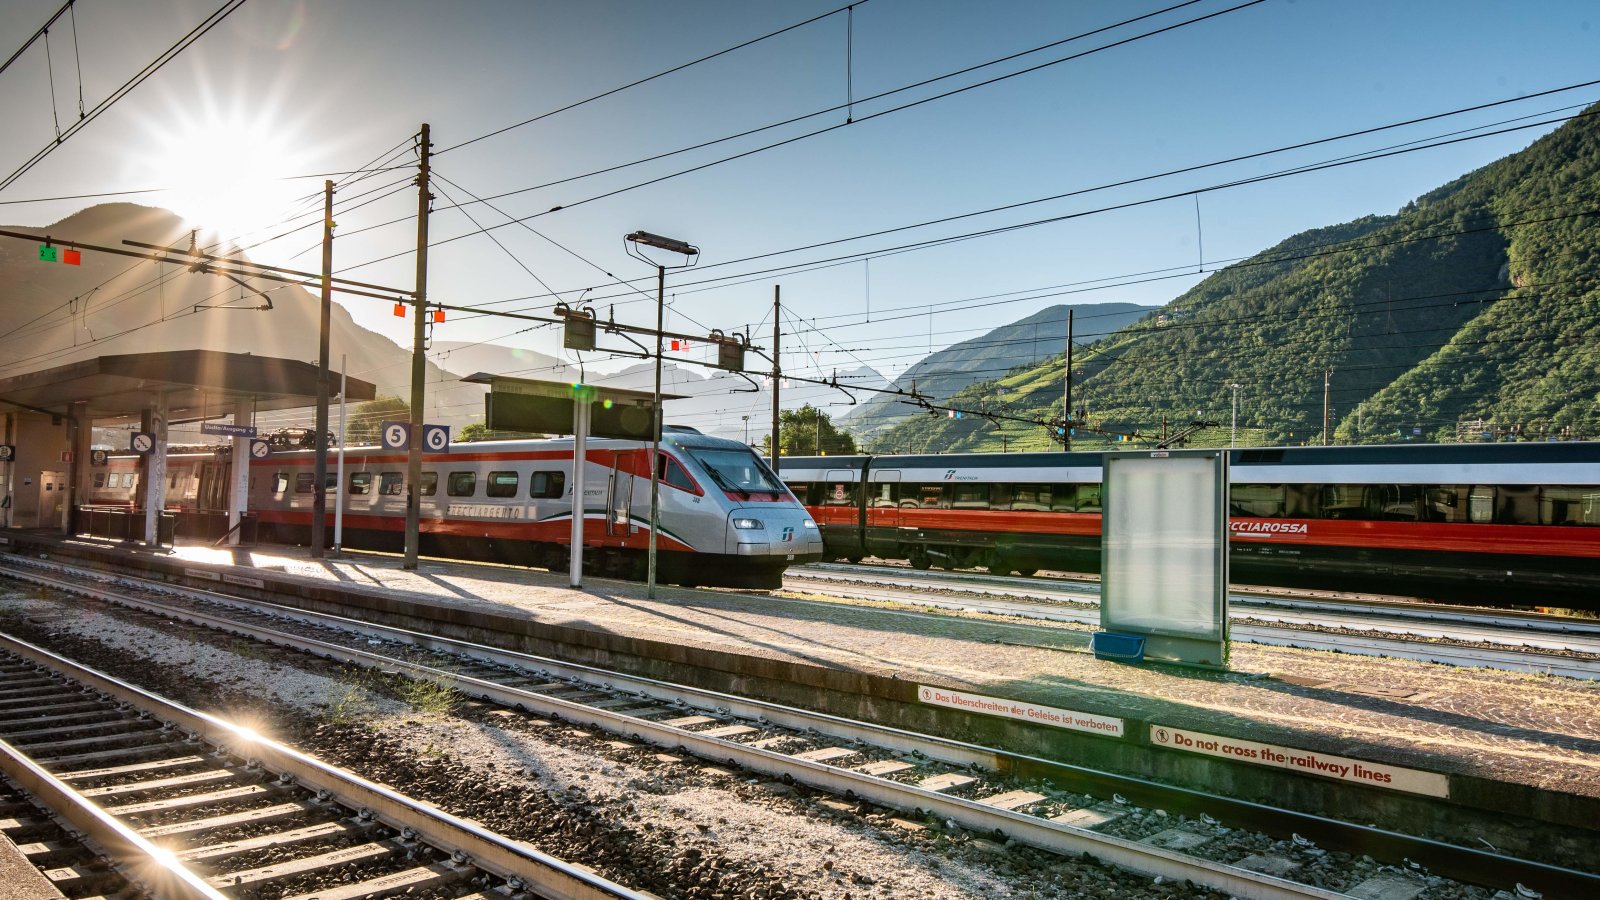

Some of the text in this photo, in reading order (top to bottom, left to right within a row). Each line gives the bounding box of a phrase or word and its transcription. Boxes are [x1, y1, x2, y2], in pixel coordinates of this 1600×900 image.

[391, 428, 401, 443] 5
[431, 431, 443, 446] 6
[935, 692, 1118, 732] Das Überschreiten der Geleise ist verboten
[1174, 732, 1392, 784] Do not cross the railway lines
